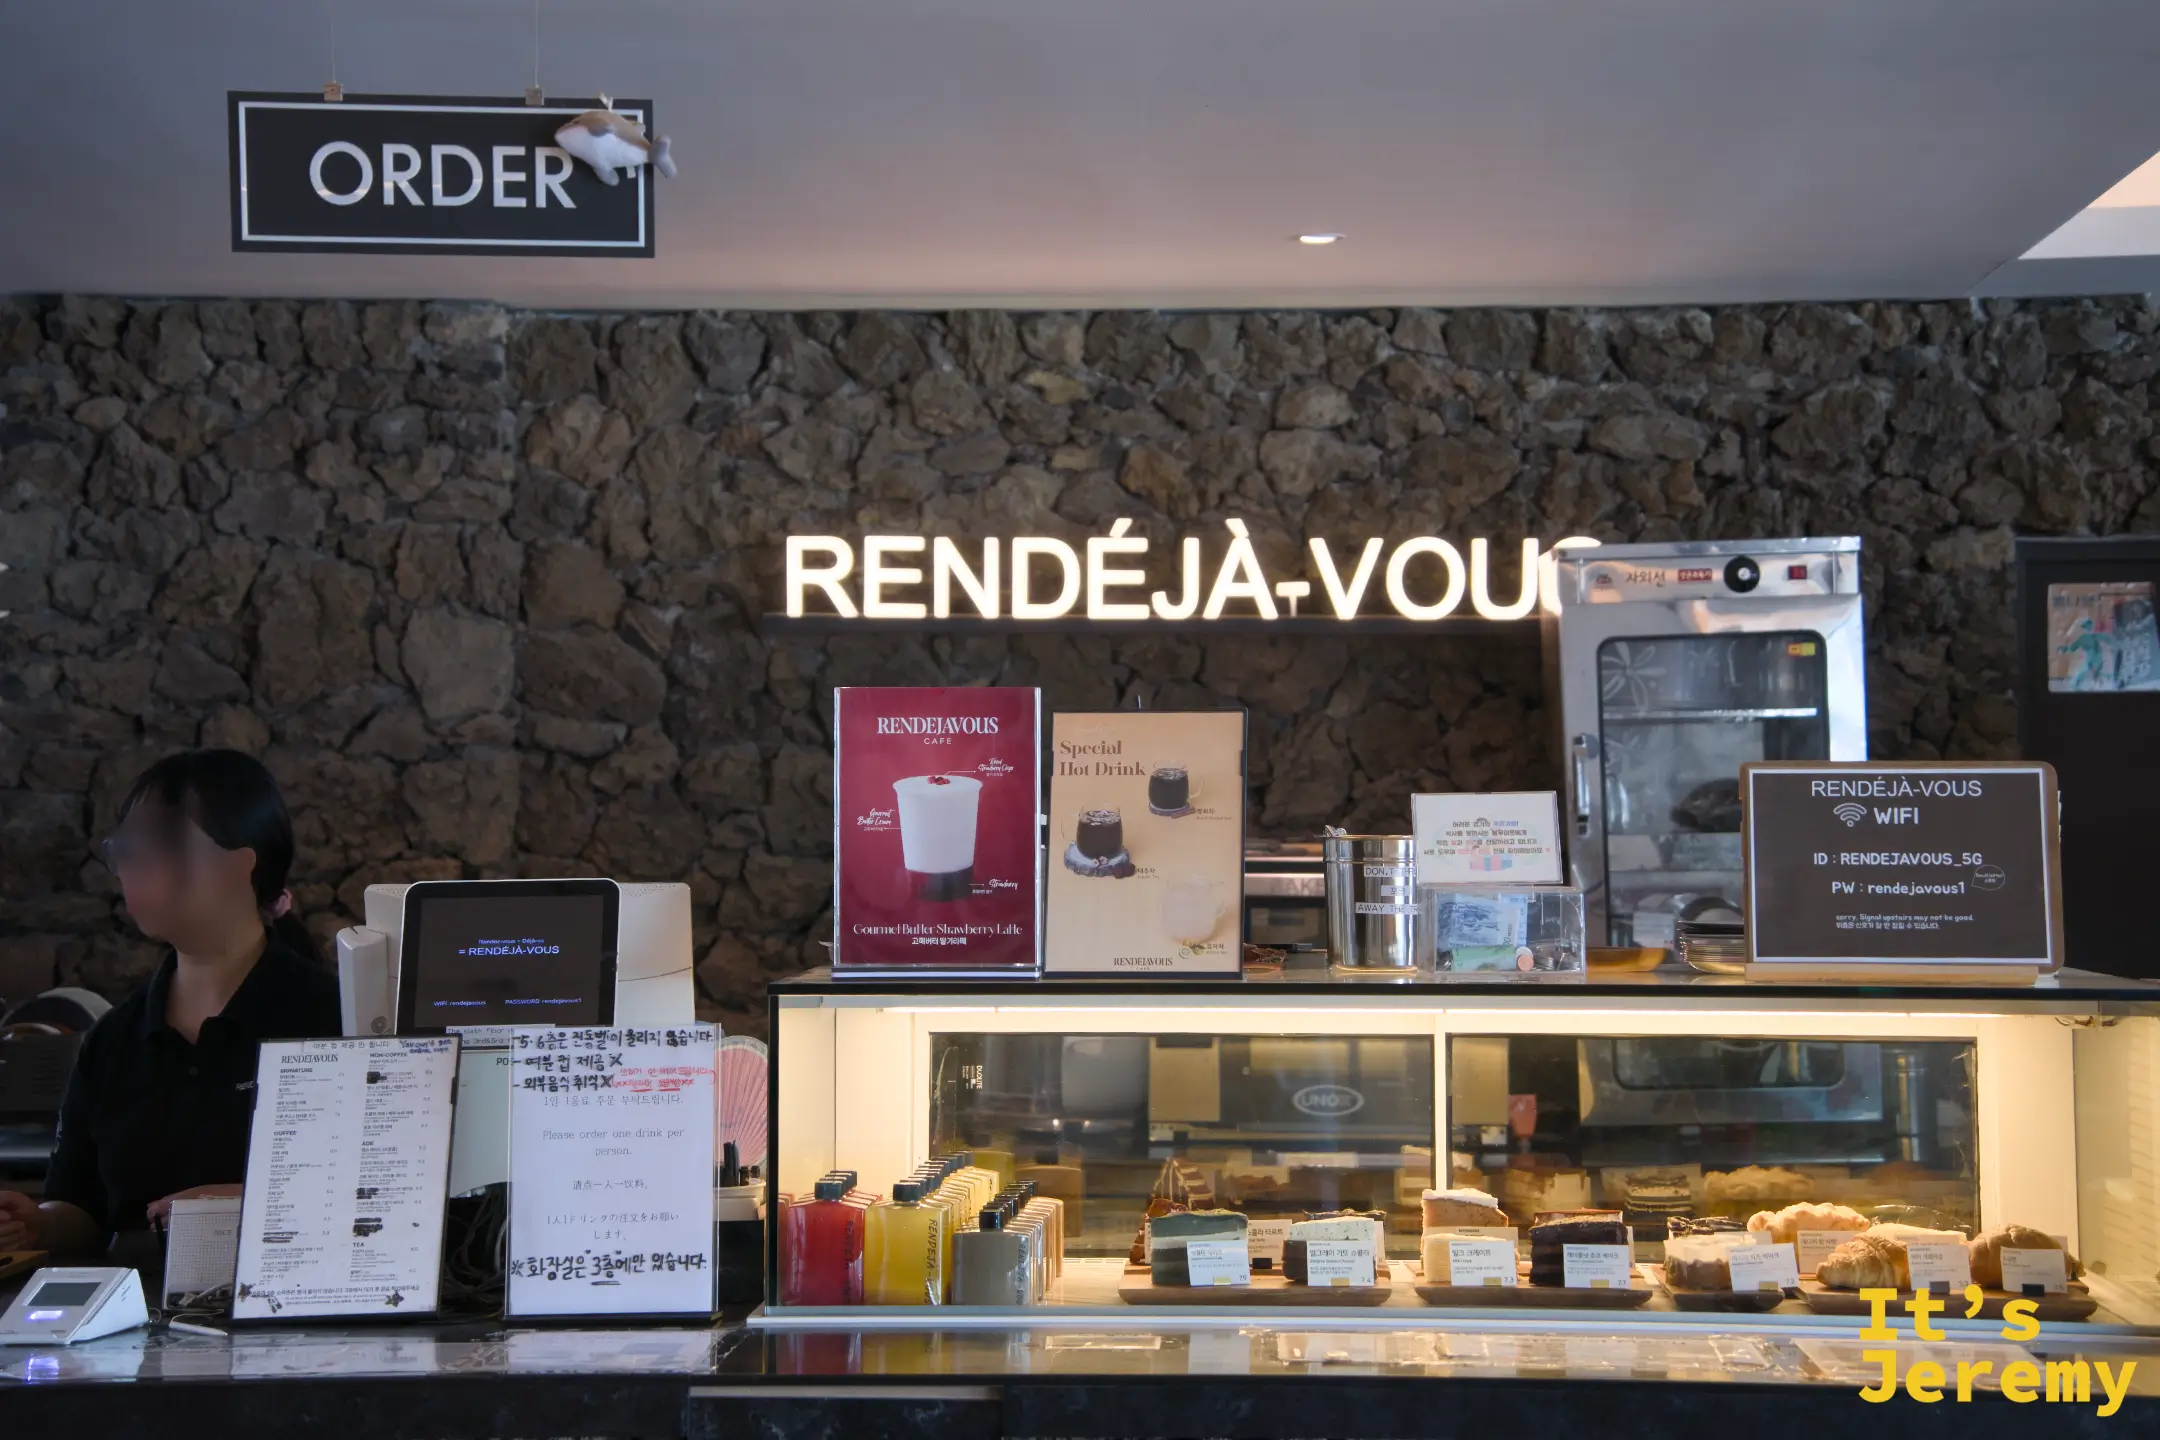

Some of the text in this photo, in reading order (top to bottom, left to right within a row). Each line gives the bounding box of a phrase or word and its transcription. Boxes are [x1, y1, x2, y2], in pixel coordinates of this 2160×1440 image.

[309, 141, 577, 209] ORDER
[786, 518, 1601, 620] RENDÉJÀ-VOU
[877, 717, 998, 735] RENDEJAVOUS
[1060, 741, 1122, 758] Special
[1060, 762, 1146, 776] Hot Drink
[1812, 776, 1982, 797] RENDÉJÀ-VOUS
[1874, 808, 1919, 824] WIFI
[1814, 853, 1828, 865] ID
[1840, 853, 1983, 867] RENDEJAVOUS_5G
[989, 879, 1018, 890] Strawberry
[1832, 882, 1854, 894] PW
[1868, 882, 1965, 896] rendejavous1
[1358, 904, 1384, 912] AWAY
[853, 924, 1022, 938] Gourmet Butter Strawberry Latte
[912, 937, 938, 945] 고메버터
[469, 945, 559, 955] RENDÉJÀ-VOUS
[1114, 958, 1173, 966] RENDEJAVOUS
[625, 1029, 661, 1047] 울리지
[281, 1054, 339, 1064] RENDEJAVOUS
[525, 1054, 554, 1069] 여분
[557, 1055, 570, 1073] 컵
[576, 1054, 605, 1071] 제공
[523, 1076, 570, 1093] 외부음식
[596, 1095, 614, 1106] 주문
[621, 1094, 683, 1105] 부탁드립니다.
[542, 1130, 575, 1140] Please
[580, 1130, 608, 1139] order
[636, 1129, 663, 1138] drink
[667, 1129, 684, 1139] per
[595, 1147, 632, 1157] person.
[1309, 1249, 1335, 1258] 얼그레이
[1451, 1249, 1491, 1257] 밀크 크레이프
[1602, 1252, 1619, 1260] 케이크
[527, 1255, 587, 1280] 화장실은
[651, 1252, 707, 1272] 있습니다.
